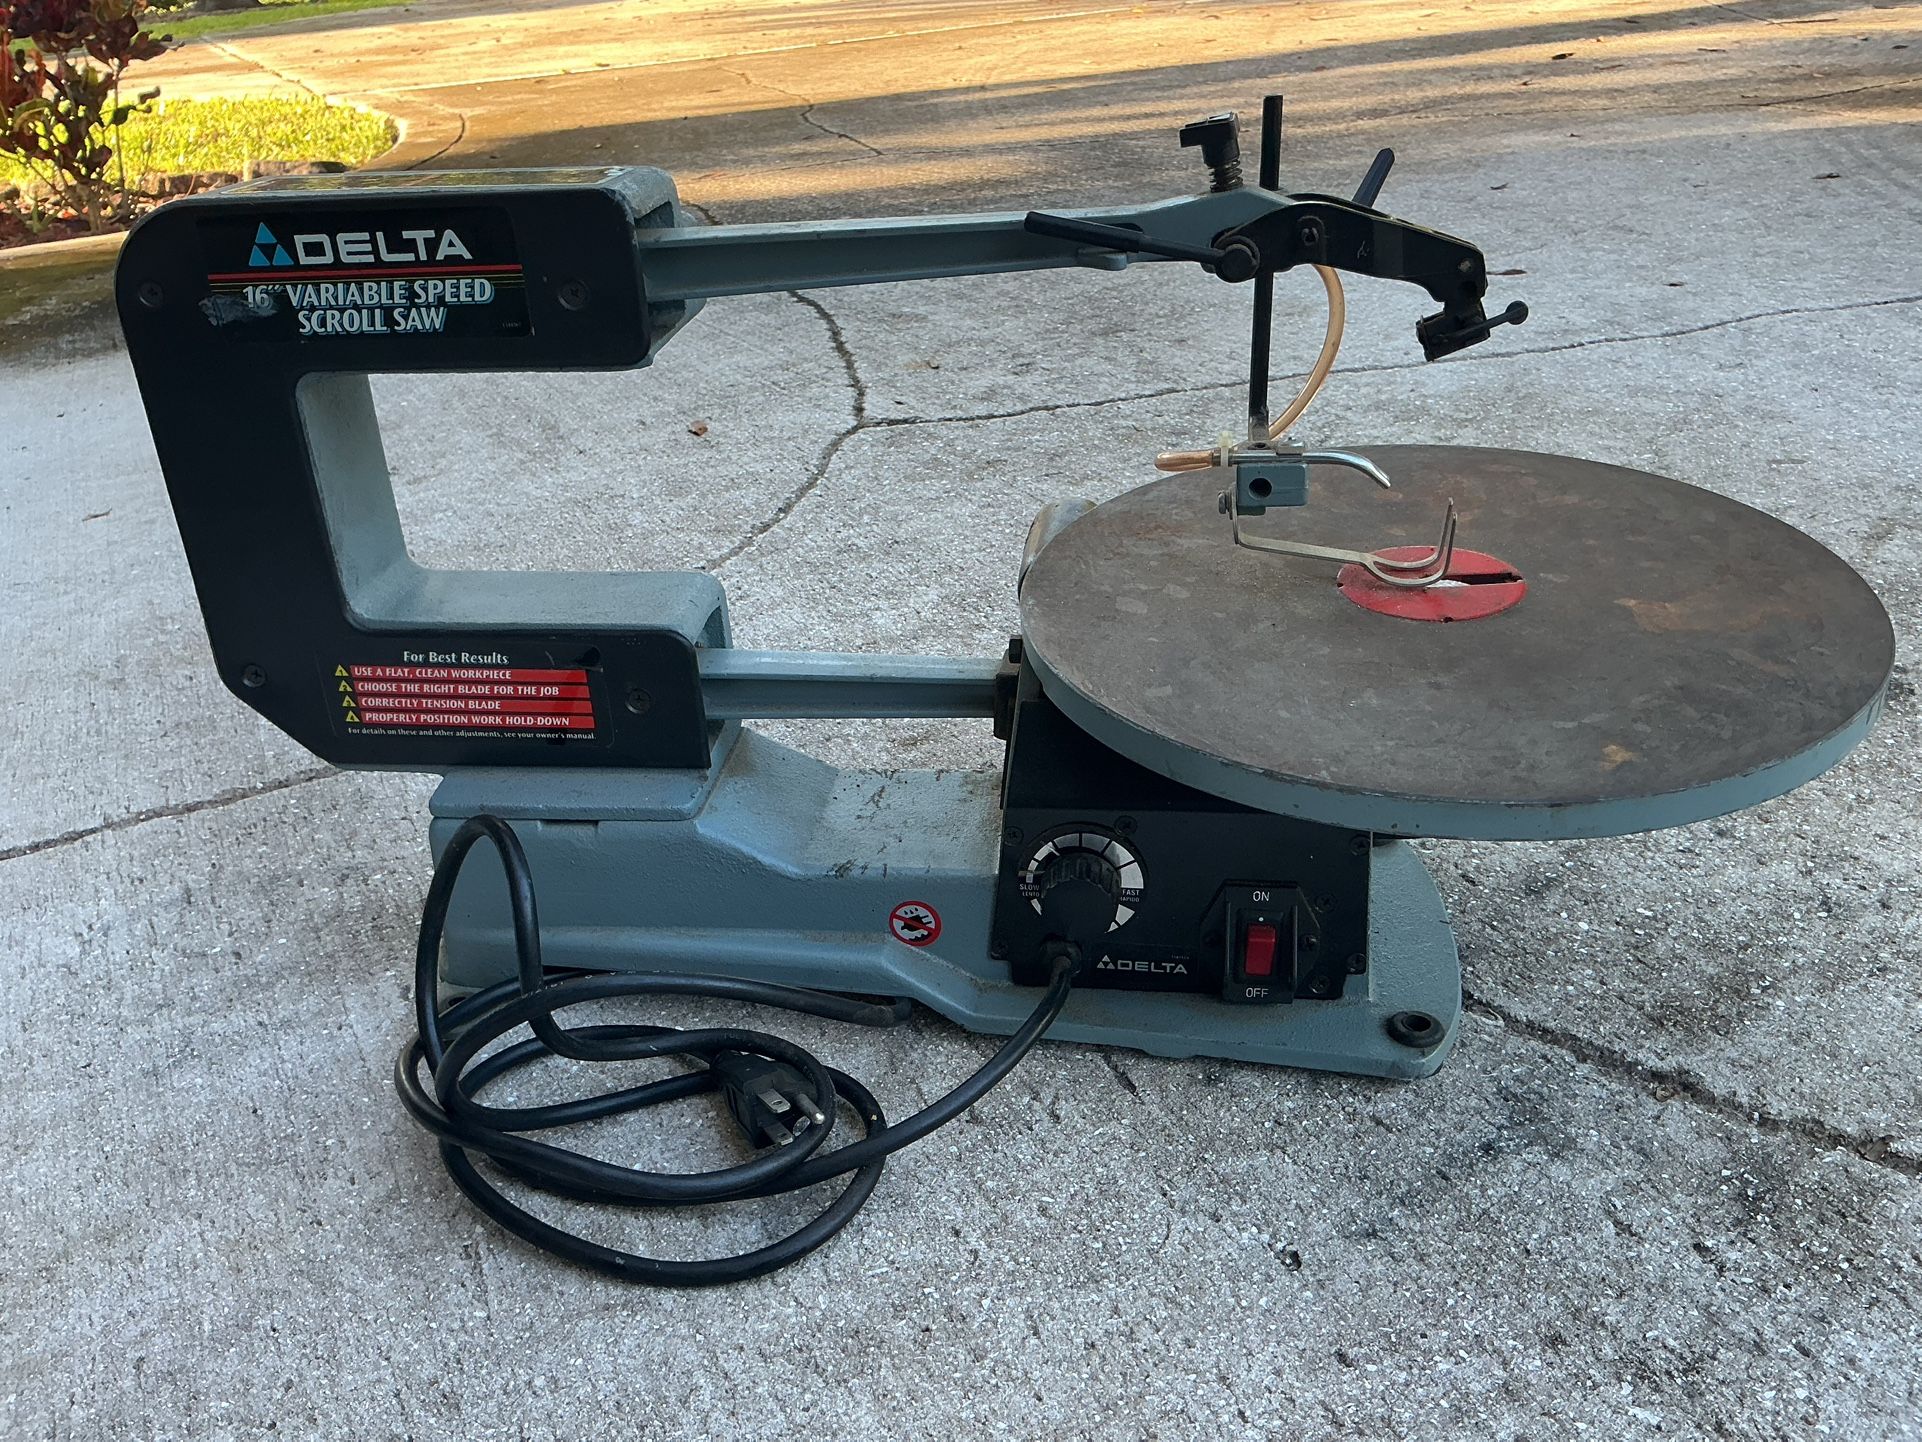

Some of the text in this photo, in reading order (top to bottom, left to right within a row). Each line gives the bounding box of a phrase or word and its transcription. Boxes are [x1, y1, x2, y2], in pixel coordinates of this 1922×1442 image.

[294, 228, 473, 265] DELTA
[242, 278, 495, 309] 16" VARIABLE SPEED
[298, 306, 447, 335] SCROLL SAW
[403, 650, 425, 663] For
[429, 651, 456, 663] Best
[354, 667, 373, 677] USE
[375, 668, 383, 677] A
[386, 668, 413, 678] FLAT,
[416, 669, 448, 678] CLEAN
[451, 670, 512, 680] WORKPIECE
[358, 682, 397, 693] CHOOSE
[401, 683, 421, 693] THE
[424, 684, 455, 694] RIGHT
[458, 685, 490, 695] BLADE
[494, 685, 514, 695] FOR
[516, 686, 537, 696] THE
[539, 686, 560, 697] JOB
[361, 698, 419, 708] CORRECTLY
[422, 699, 465, 709] TENSION
[468, 701, 501, 710] BLADE
[365, 712, 418, 723] PROPERLY
[421, 714, 468, 724] POSITION
[472, 716, 503, 725] WORK
[506, 716, 570, 726] HOLD-DOWN
[348, 727, 361, 735] For
[362, 727, 386, 736] details
[398, 728, 417, 736] these
[419, 729, 433, 737] and
[434, 729, 453, 737] other
[517, 732, 534, 740] your
[536, 732, 565, 740] owner's
[1019, 883, 1040, 891] SLOW
[1252, 890, 1270, 902] ON
[1117, 960, 1188, 975] DELTA
[1245, 986, 1269, 998] OFF
